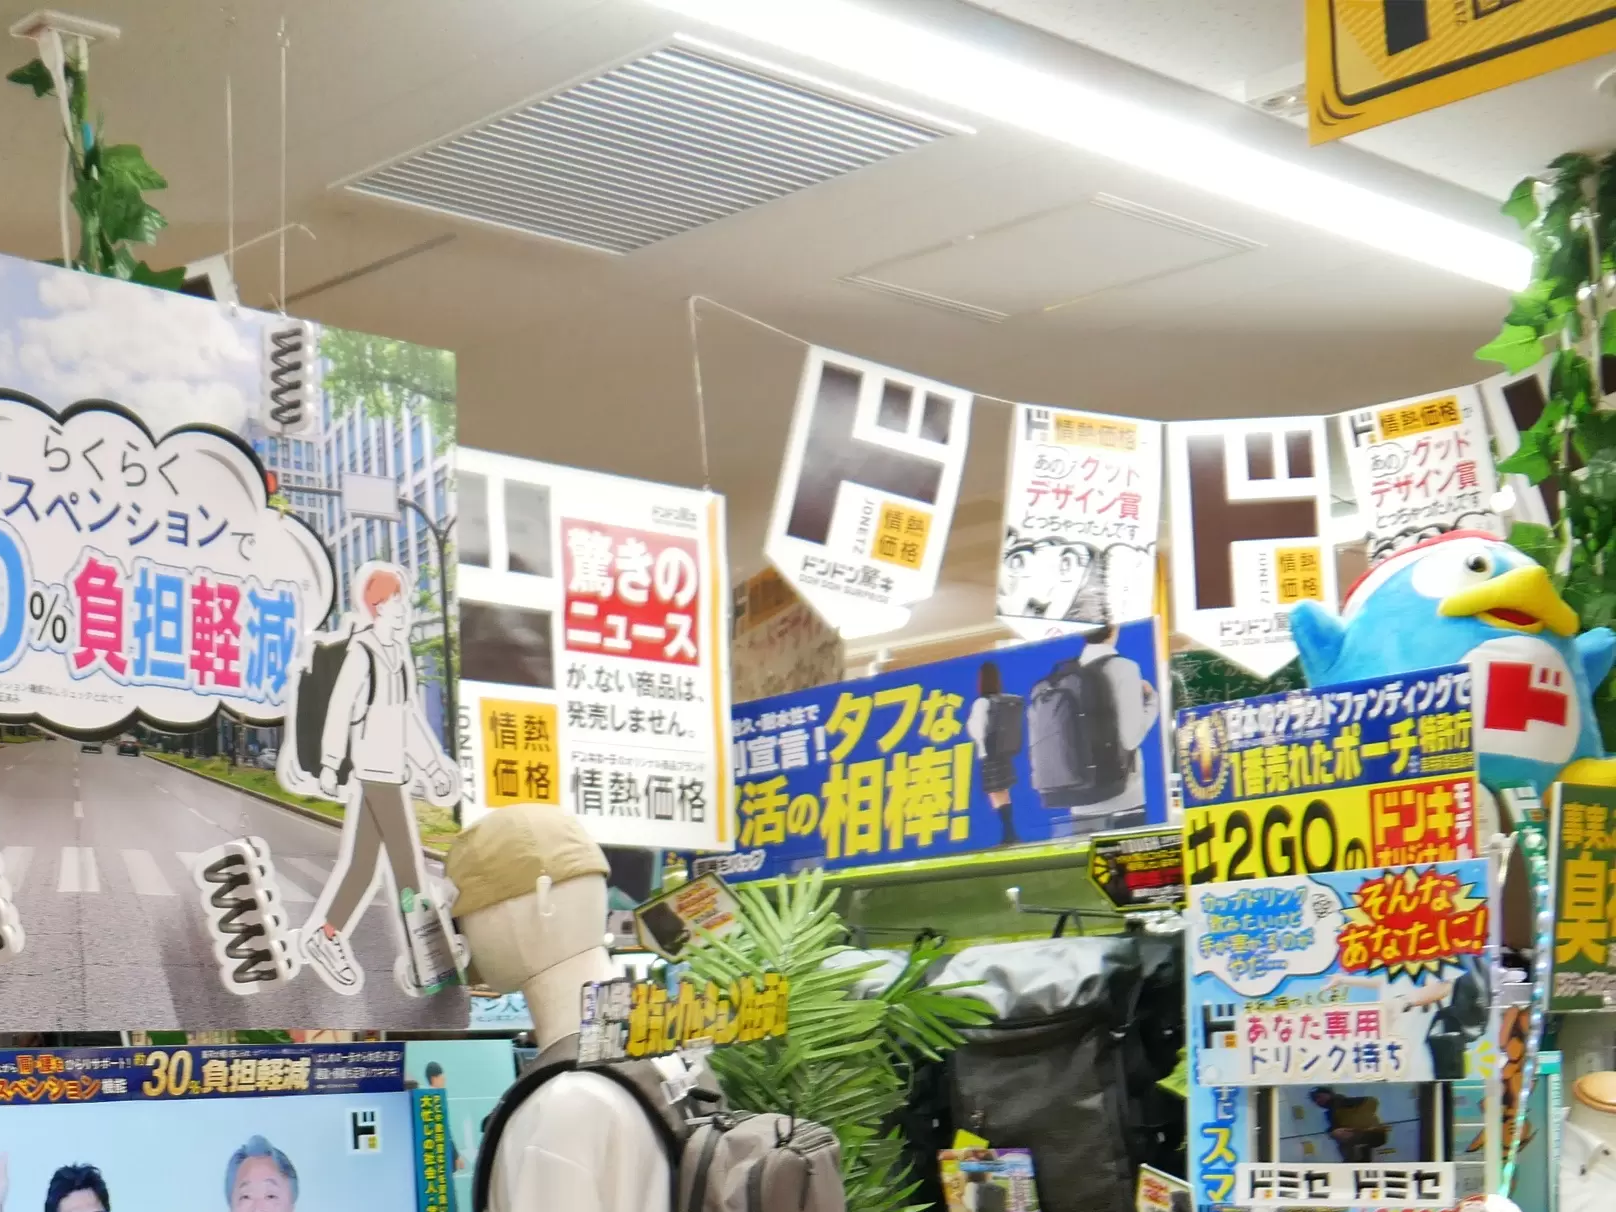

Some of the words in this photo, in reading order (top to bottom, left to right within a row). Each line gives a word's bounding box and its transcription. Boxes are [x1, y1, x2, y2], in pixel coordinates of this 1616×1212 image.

[41, 423, 180, 497] らくらく
[1026, 479, 1143, 521] デザイン賞
[1371, 460, 1479, 507] デザイン賞
[1022, 513, 1140, 541] とっちゃったんです
[566, 527, 697, 608] 驚きの
[566, 600, 697, 659] ニュース
[489, 710, 551, 754] 情熱
[567, 700, 696, 740] 発売しません。
[824, 684, 965, 763] タフな
[492, 757, 552, 801] 価格
[1232, 718, 1418, 797] 1番売れたポーチ
[571, 766, 707, 824] 情熱価格
[821, 742, 974, 860] 相棒!
[1374, 785, 1453, 846] ドンキ
[1359, 875, 1457, 921] そんな
[1340, 911, 1485, 968] あなたに!
[1247, 1010, 1381, 1043] あなた専用
[201, 1057, 312, 1093] 負担軽減
[1249, 1041, 1403, 1075] ドリンク持ち
[1250, 1169, 1330, 1200] ドミセ
[1354, 1168, 1440, 1200] ドミセ
